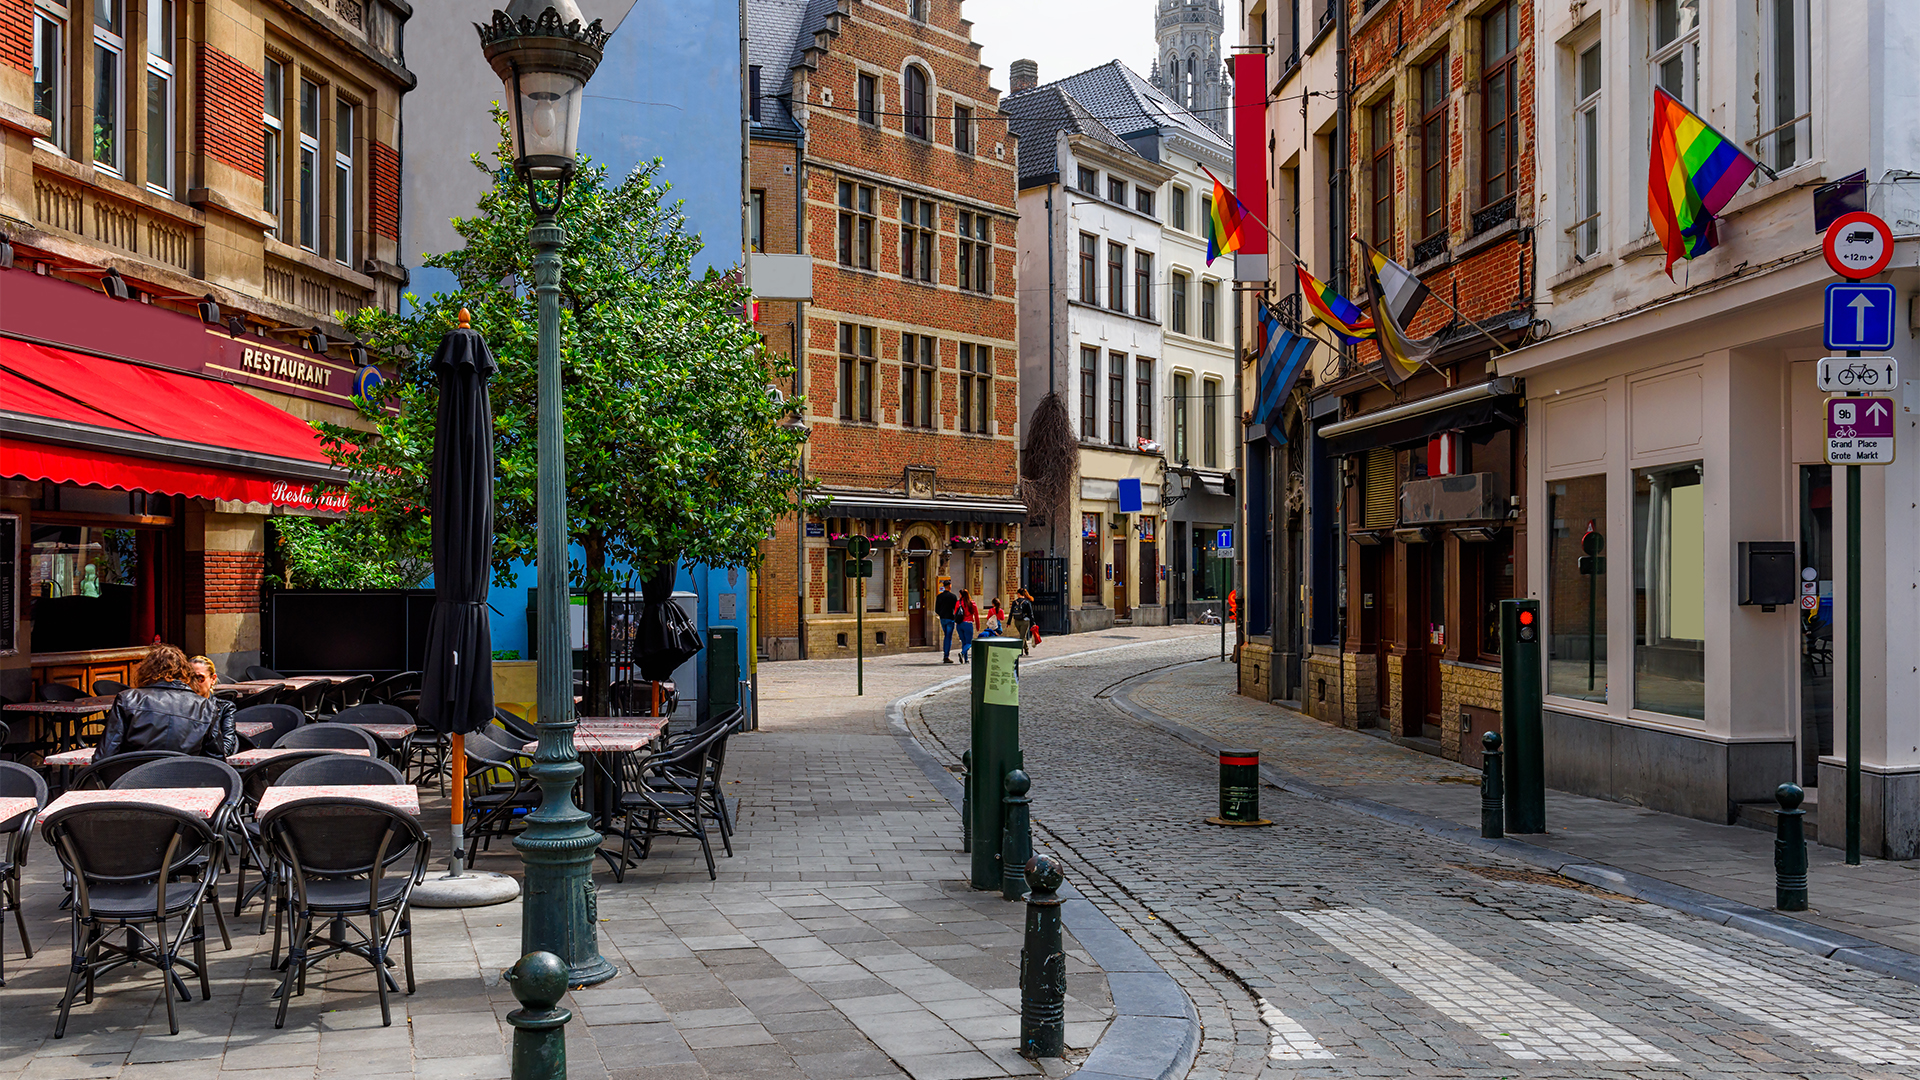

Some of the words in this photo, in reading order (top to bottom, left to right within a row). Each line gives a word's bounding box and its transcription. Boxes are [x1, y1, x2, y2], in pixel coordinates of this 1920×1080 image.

[243, 348, 332, 386] RESTAURANT
[1838, 409, 1851, 419] 9b
[1831, 440, 1852, 448] Grand
[1857, 440, 1878, 448] Place
[1831, 451, 1851, 460] Grote
[1856, 451, 1879, 460] Markt
